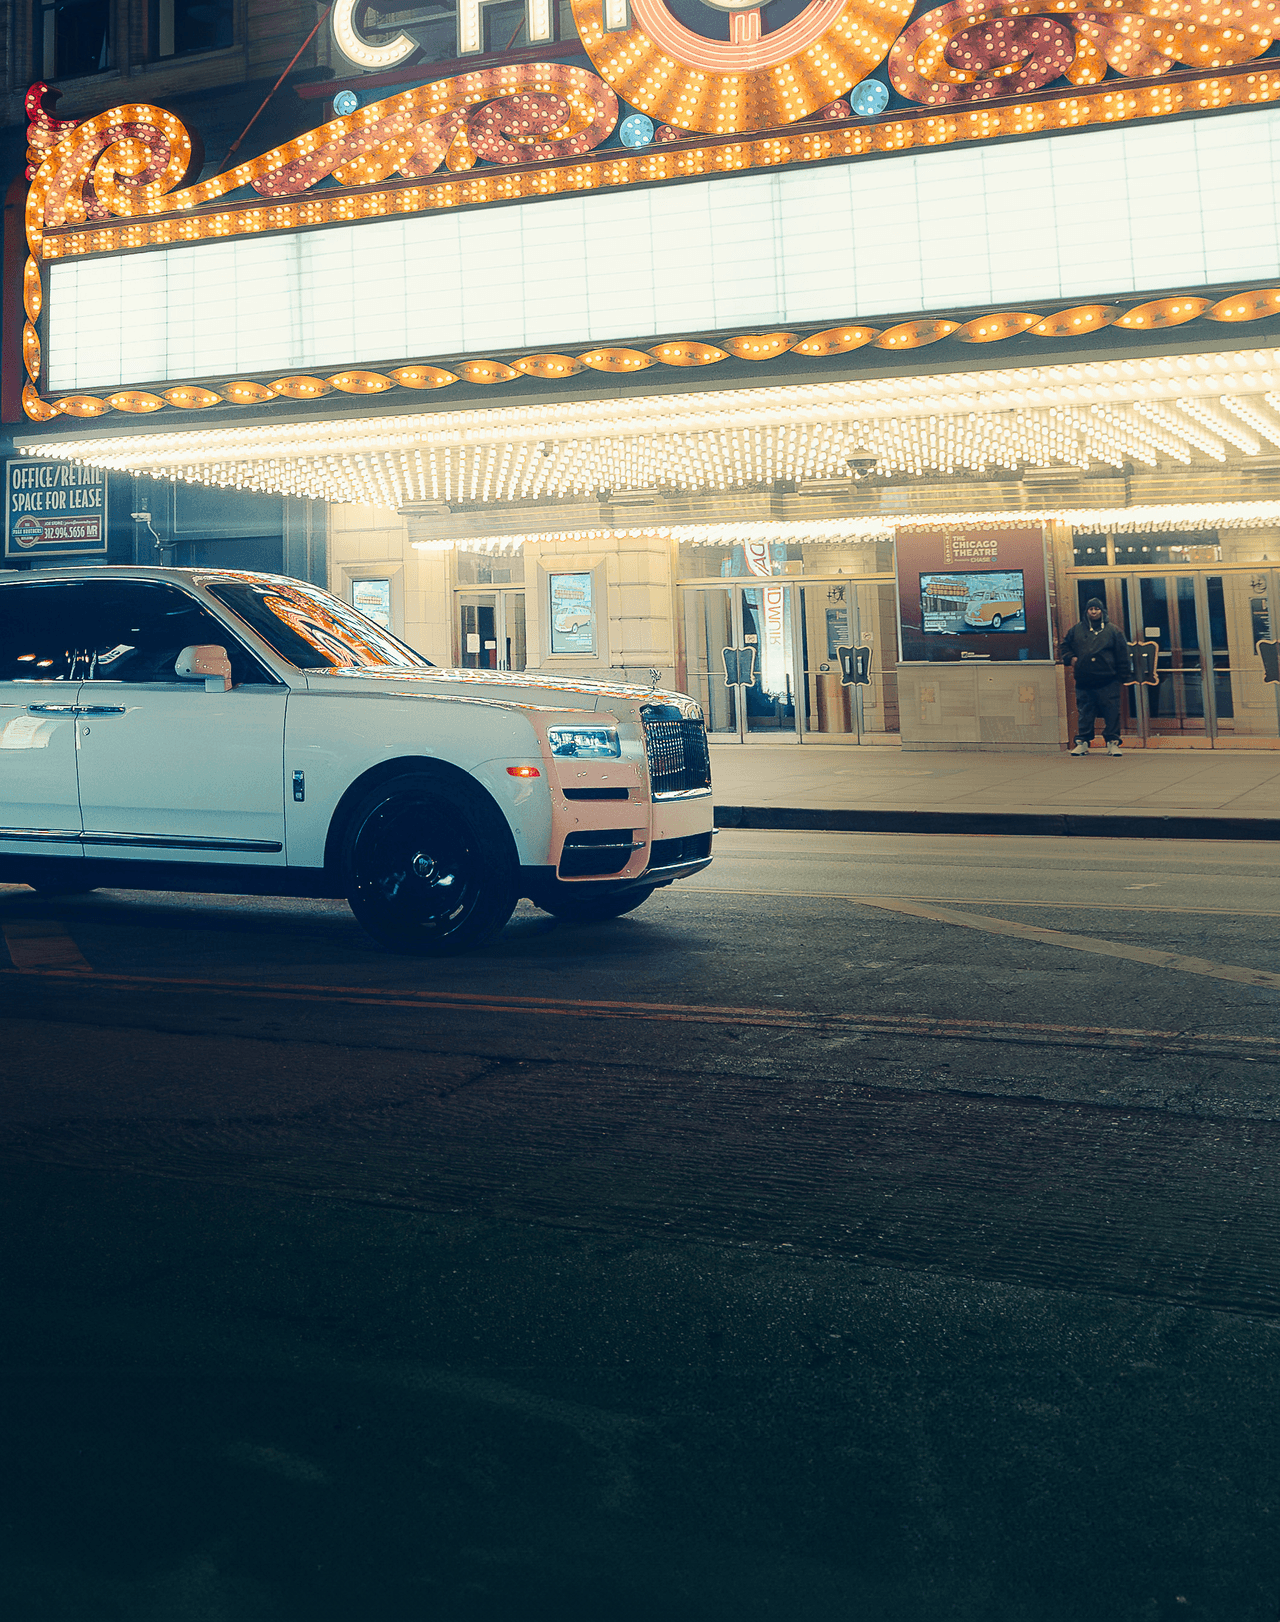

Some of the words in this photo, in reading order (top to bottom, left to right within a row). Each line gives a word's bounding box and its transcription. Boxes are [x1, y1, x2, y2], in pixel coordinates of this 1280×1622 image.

[12, 465, 102, 490] OFFICE/RETAIL
[12, 492, 43, 512] SPACE
[45, 490, 66, 510] FOR
[69, 488, 102, 509] LEASE
[44, 526, 85, 539] 312.994.5656
[952, 540, 998, 549] CHICAGO
[952, 548, 998, 557] THEATRE
